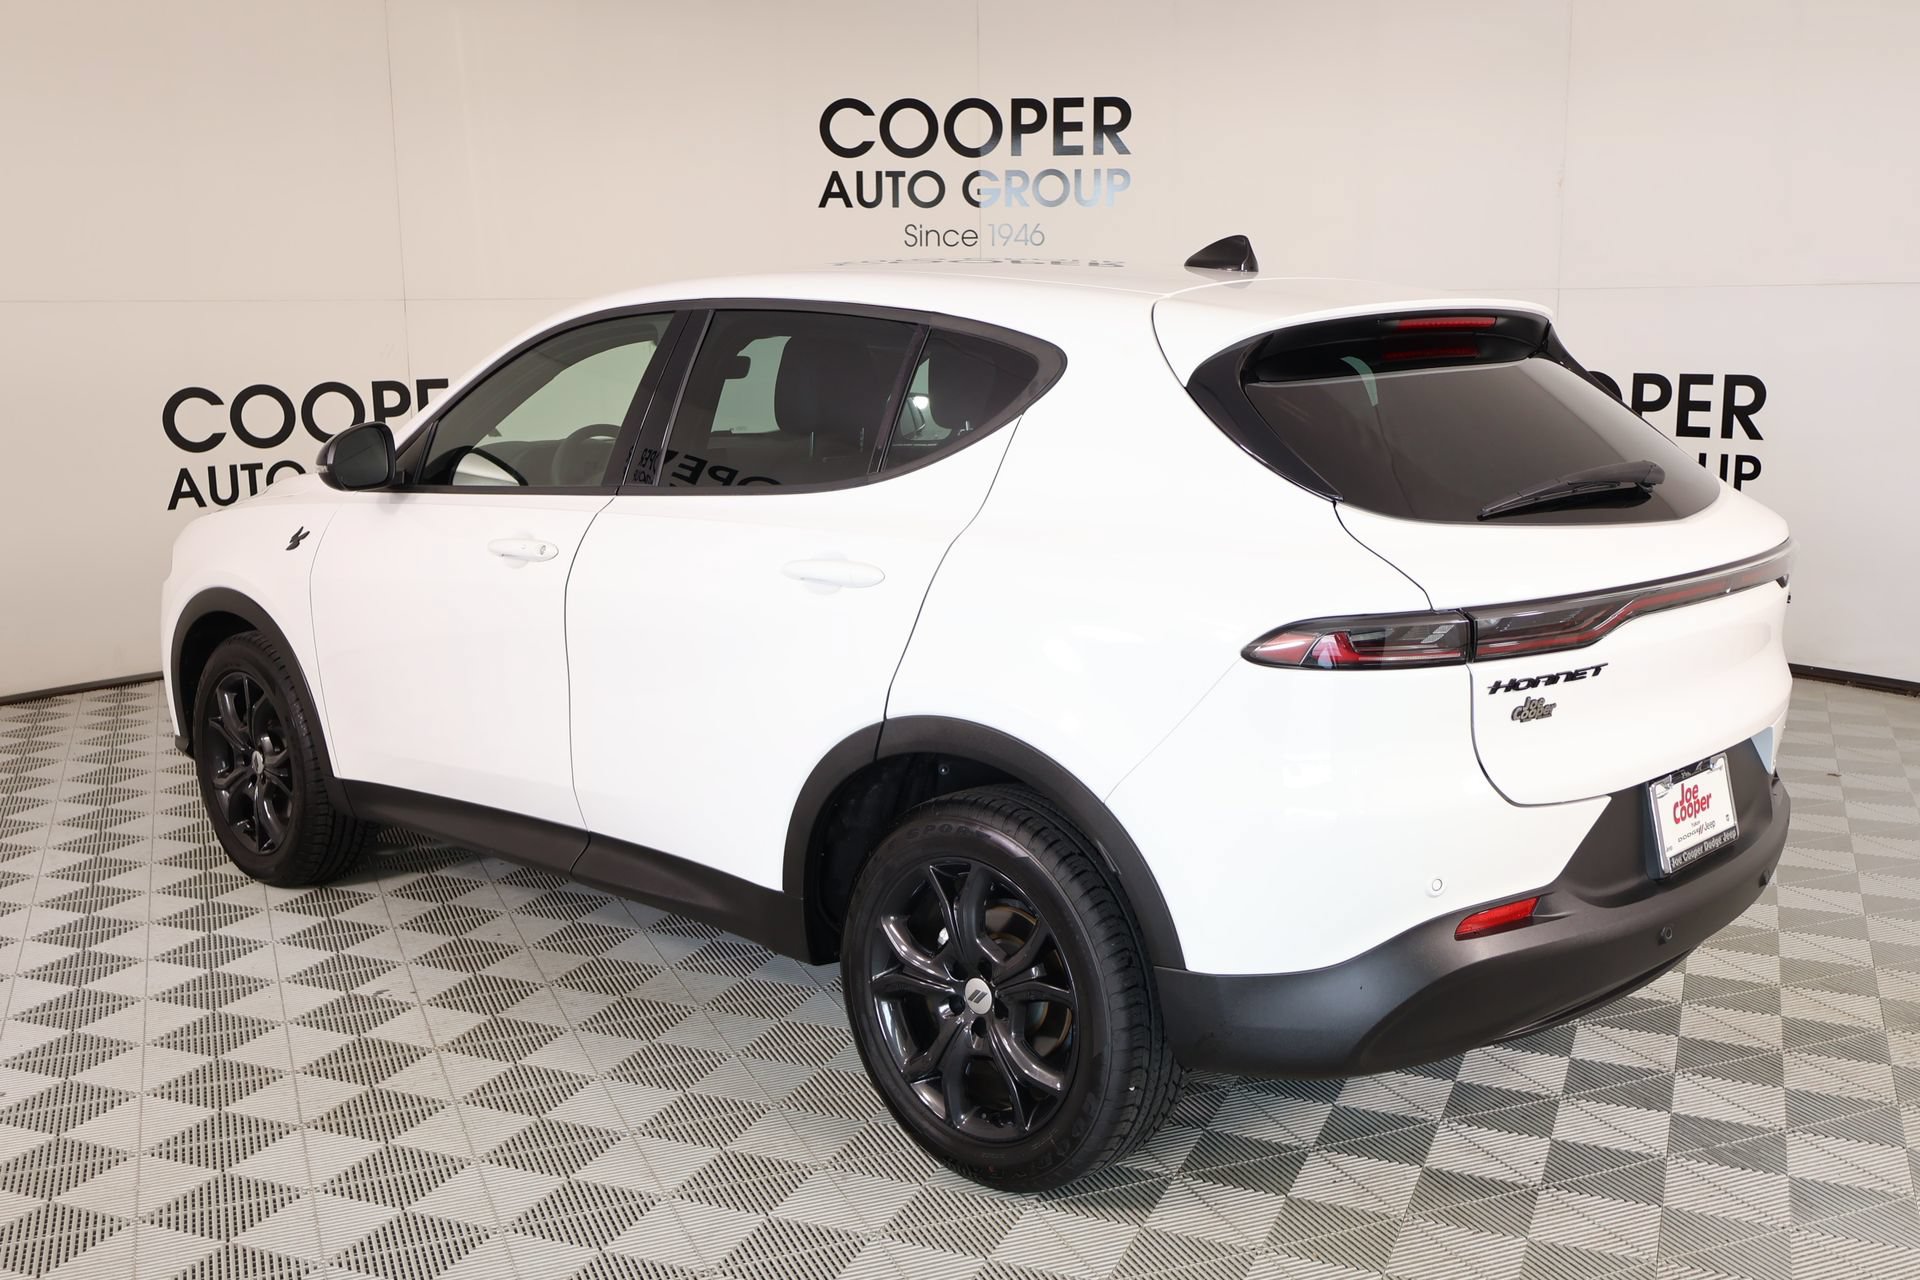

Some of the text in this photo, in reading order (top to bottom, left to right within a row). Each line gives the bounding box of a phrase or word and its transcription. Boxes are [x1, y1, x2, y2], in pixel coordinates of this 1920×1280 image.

[819, 96, 1132, 158] COOPER
[818, 168, 1132, 209] AUTO GROUP
[904, 223, 1046, 247] Since 1946
[1487, 662, 1609, 695] HORNET
[1511, 703, 1557, 721] Cooper
[1523, 696, 1546, 711] Joe
[1679, 783, 1699, 806] Joe
[1673, 793, 1712, 824] Cooper
[1704, 820, 1716, 831] Jeep
[1671, 856, 1682, 868] Joe
[1683, 845, 1703, 862] Cooper
[1704, 835, 1722, 851] Dodge
[1723, 829, 1736, 841] Jeep
